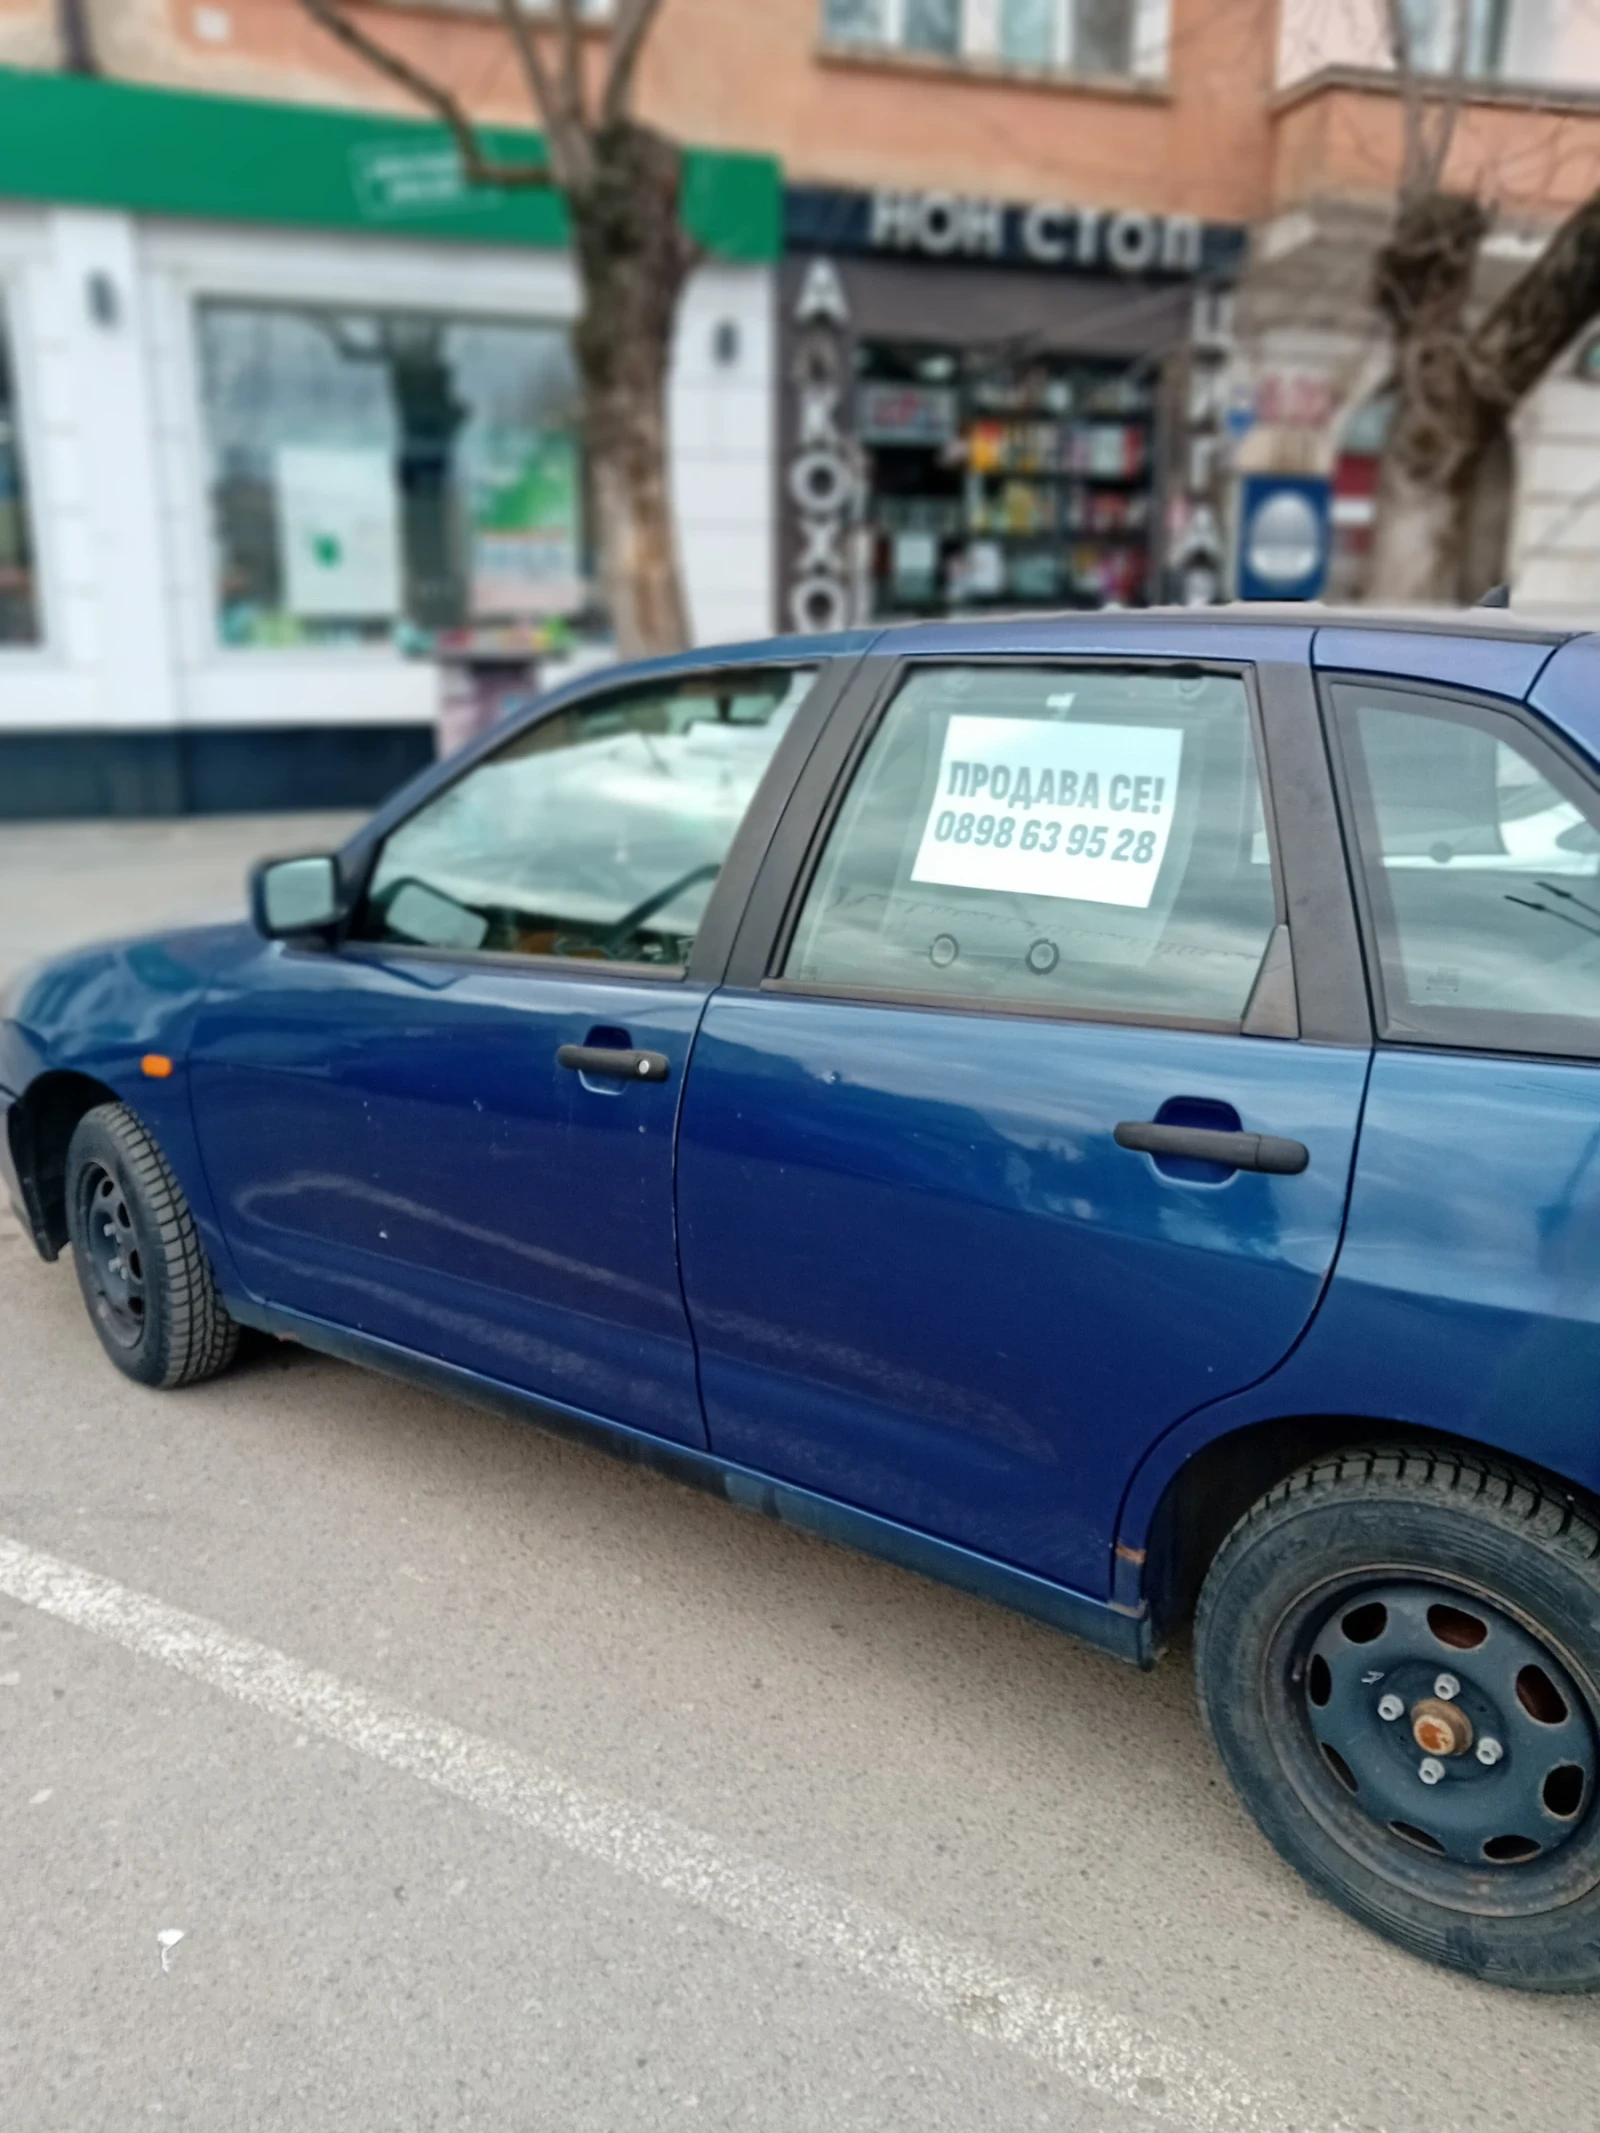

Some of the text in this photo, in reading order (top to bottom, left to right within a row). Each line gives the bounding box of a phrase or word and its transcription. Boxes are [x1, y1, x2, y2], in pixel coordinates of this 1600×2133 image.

[871, 189, 1200, 271] НОН СТОП
[790, 254, 852, 633] АЛКОХО
[947, 760, 1166, 815] ПРОДАВА СЕ!
[933, 810, 1157, 864] 0898 63 95 28
